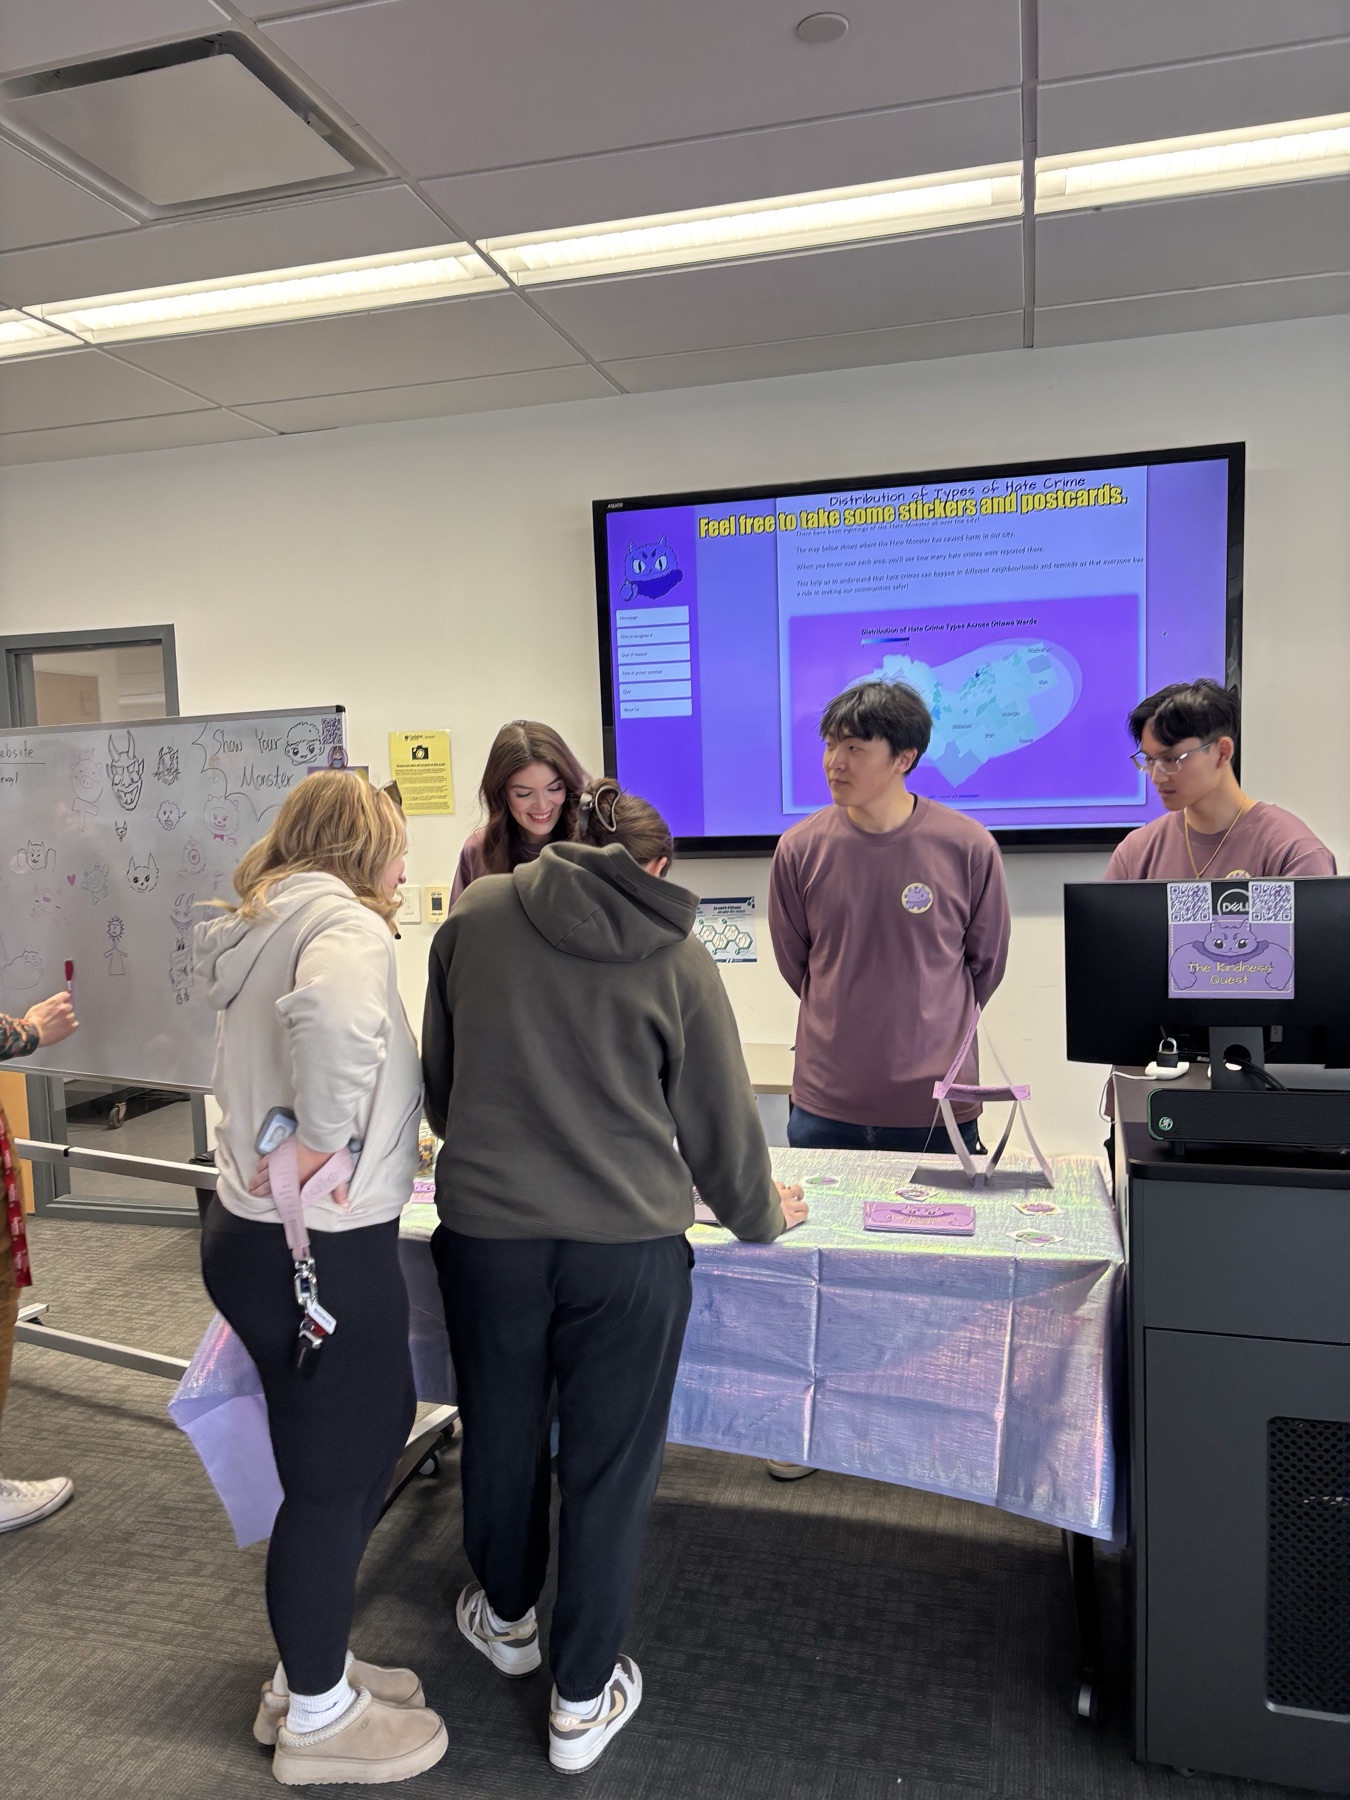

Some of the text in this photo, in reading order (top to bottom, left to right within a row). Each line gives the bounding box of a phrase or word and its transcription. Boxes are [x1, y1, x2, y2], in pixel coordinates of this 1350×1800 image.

[829, 476, 1086, 507] Distribution of Types of Hate Crime
[699, 482, 1128, 539] Feel free to take some stickers and postcards.
[808, 545, 820, 553] map
[822, 544, 839, 552] below
[905, 537, 931, 545] Monster
[213, 728, 282, 755] Show Your
[240, 763, 294, 790] Monster
[1188, 960, 1274, 974] The Kindness
[1209, 974, 1248, 985] Quest
